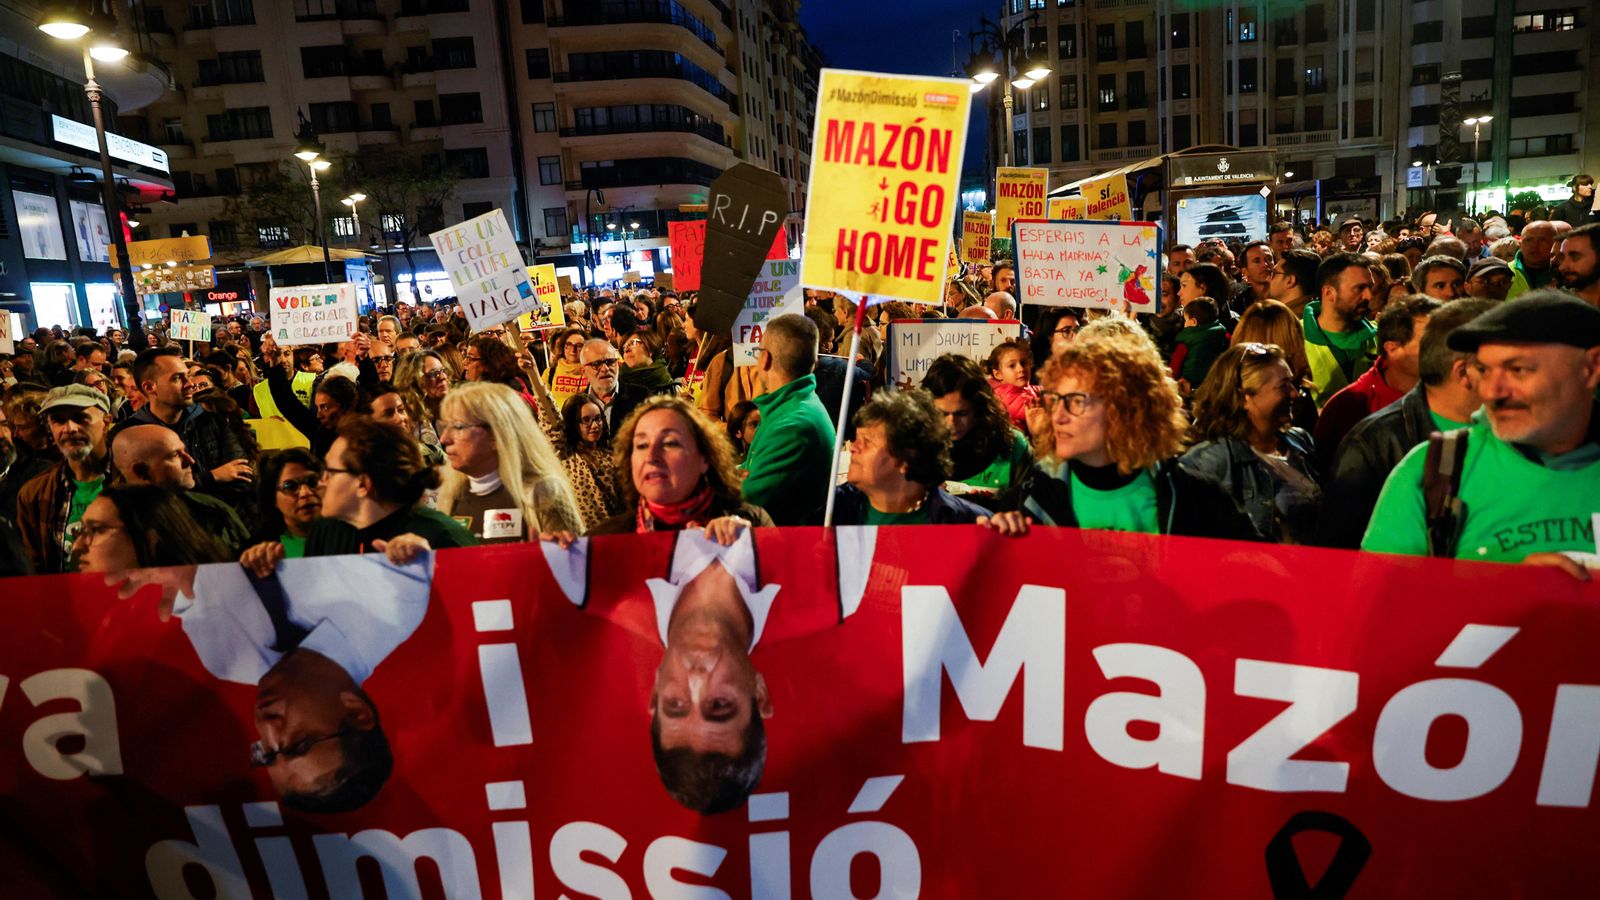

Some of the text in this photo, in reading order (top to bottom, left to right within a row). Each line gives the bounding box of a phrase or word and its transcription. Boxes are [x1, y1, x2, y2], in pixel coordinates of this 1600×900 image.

[829, 88, 918, 108] #MazónDimissió
[824, 117, 952, 174] MAZÓN
[1000, 181, 1043, 199] MAZÓN
[1100, 184, 1111, 200] sí
[1061, 205, 1076, 220] tria
[436, 216, 503, 255] PER UN
[964, 221, 990, 235] MAZÓN
[1019, 228, 1141, 246] ESPERAIS A LA
[458, 240, 496, 264] COLE
[835, 228, 938, 282] HOME
[967, 248, 989, 260] HOME
[674, 263, 691, 277] NI
[770, 261, 797, 277] UN
[1024, 266, 1094, 282] BASTA YA
[481, 277, 502, 294] DE
[535, 282, 556, 296] ncià
[1027, 285, 1108, 302] DE CUENTOS!
[208, 292, 238, 301] Orange
[277, 308, 348, 325] TORNAR
[172, 325, 210, 341] DMSIÓ
[278, 328, 289, 340] A
[740, 324, 763, 344] FA
[905, 357, 934, 372] LIMP
[472, 599, 534, 748] i
[0, 667, 124, 781] a
[145, 774, 922, 900] dimissió
